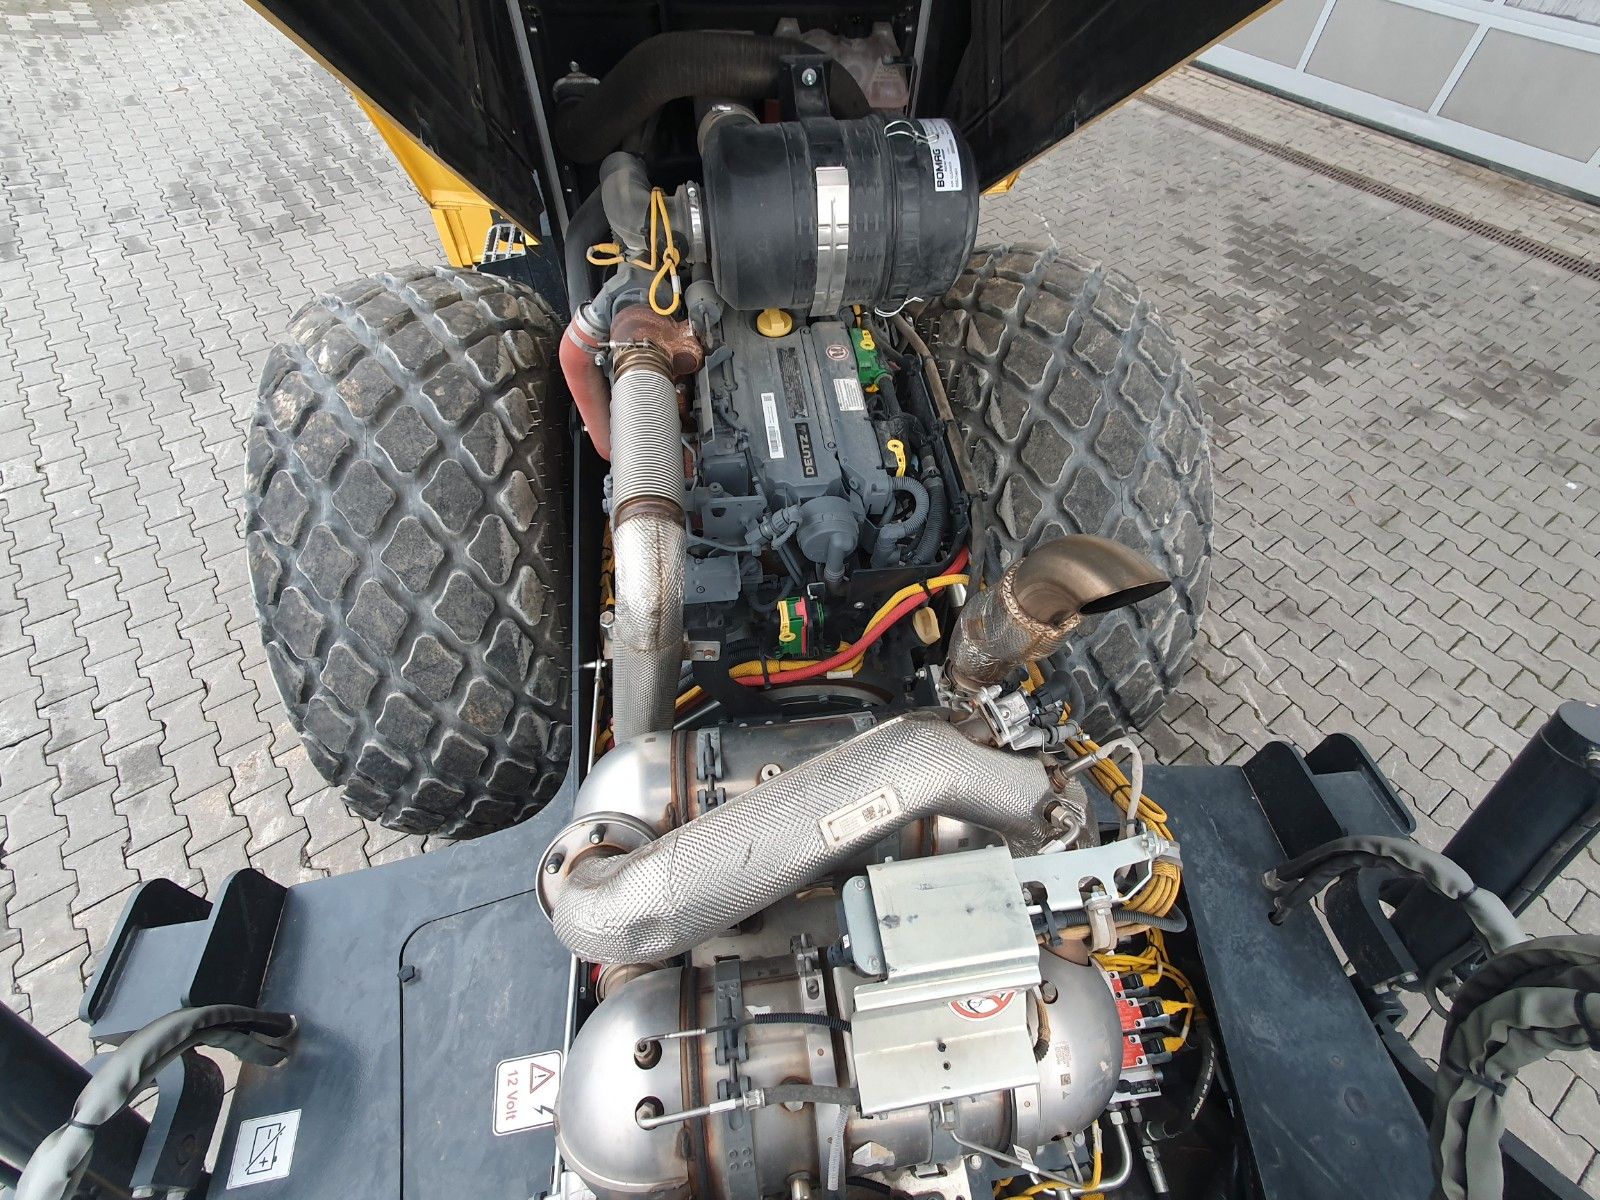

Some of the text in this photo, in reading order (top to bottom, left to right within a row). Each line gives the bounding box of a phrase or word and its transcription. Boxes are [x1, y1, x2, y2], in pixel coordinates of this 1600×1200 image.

[933, 148, 945, 188] BOMAG
[800, 434, 815, 476] DEUTZ
[506, 1069, 519, 1121] 12 Volt
